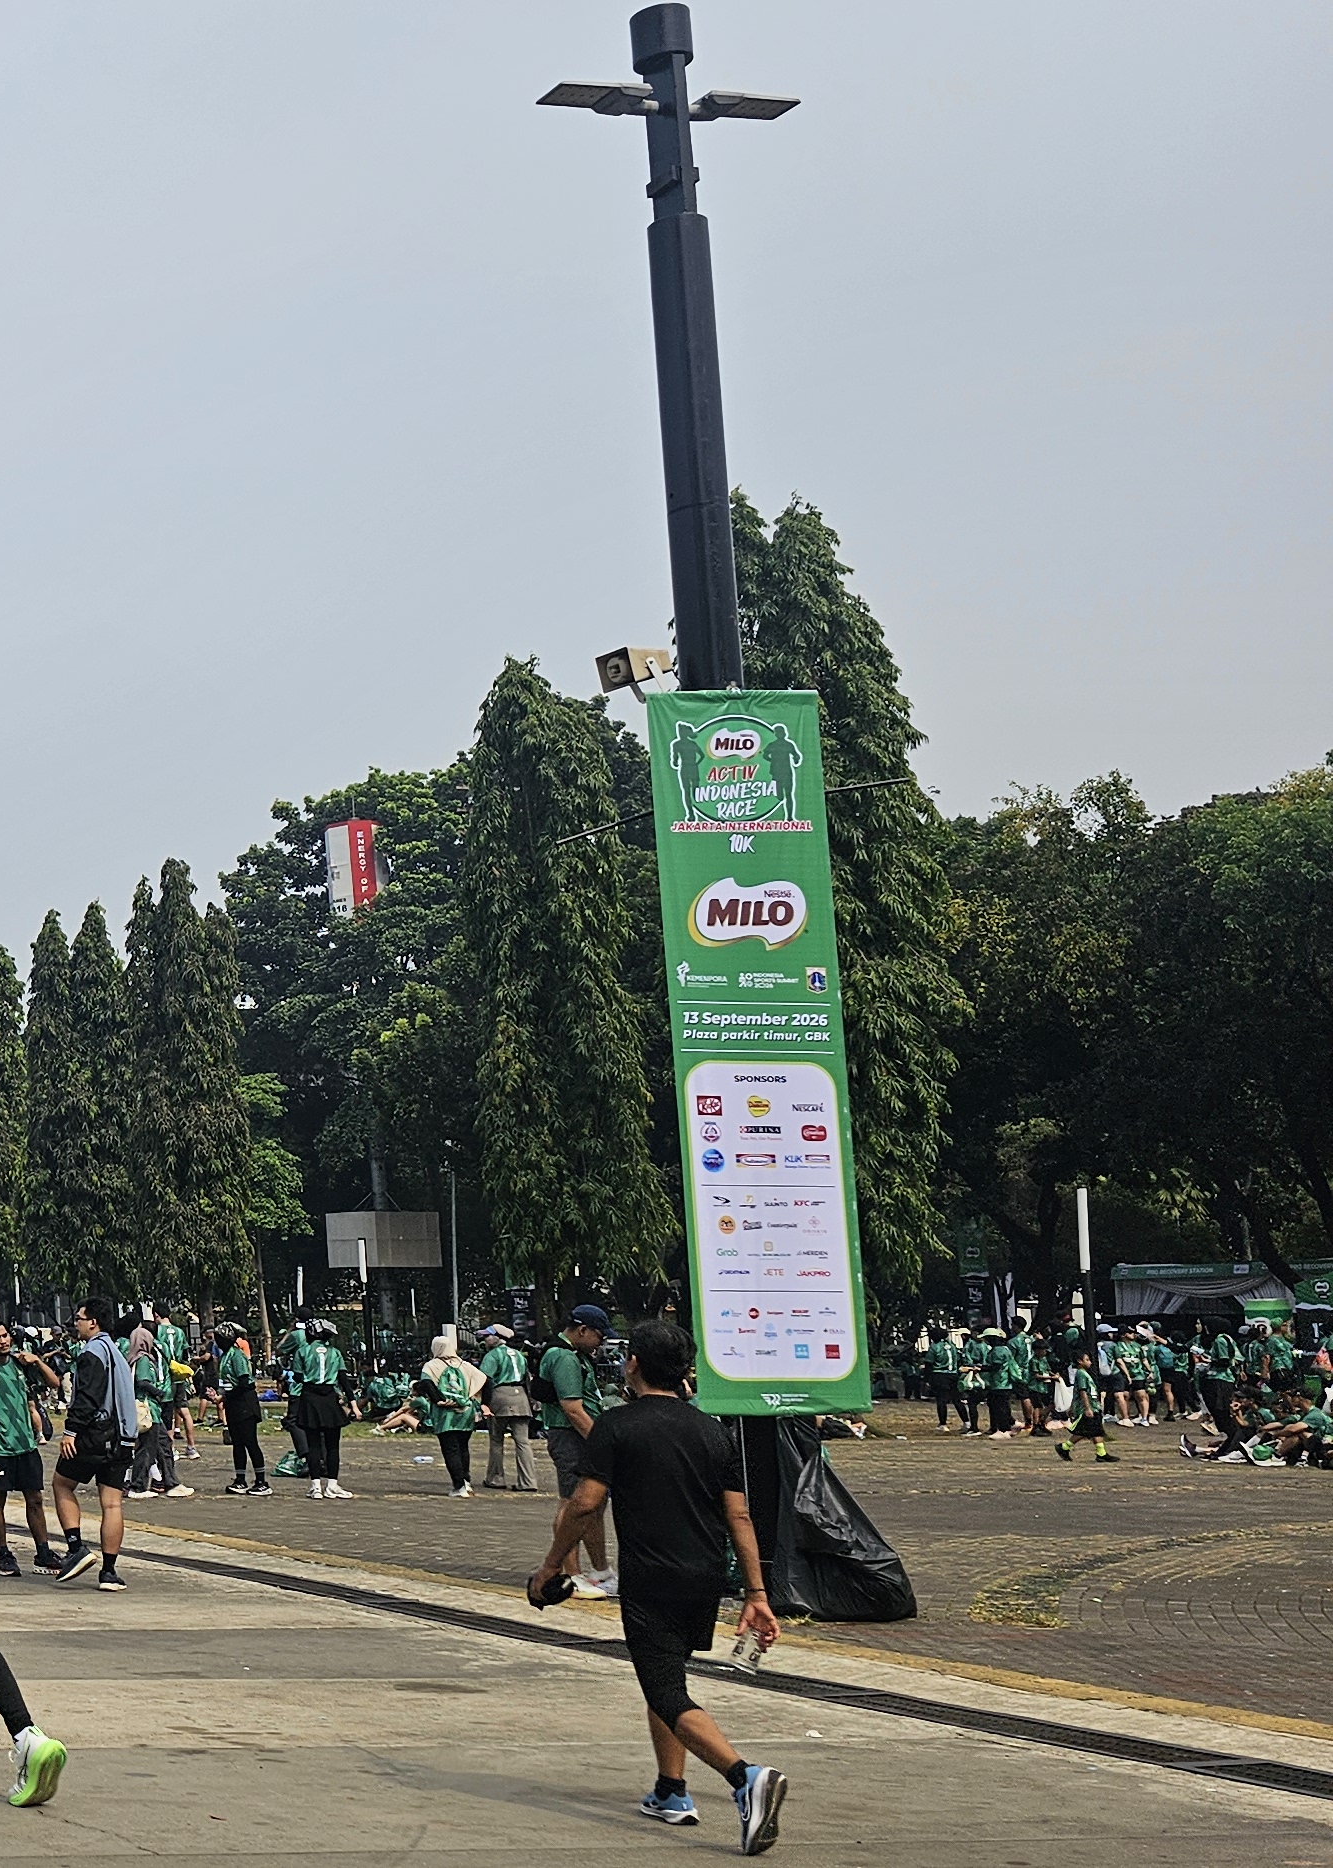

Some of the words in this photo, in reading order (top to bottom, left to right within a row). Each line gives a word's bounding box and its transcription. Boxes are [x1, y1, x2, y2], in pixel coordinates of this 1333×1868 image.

[715, 738, 754, 751] MILO
[707, 764, 759, 782] ACTIV
[695, 780, 777, 803] INDONESIA
[716, 799, 757, 819] RACE
[671, 822, 724, 832] JAKARTA
[725, 821, 813, 832] INTERNATIONAL
[729, 833, 756, 853] 10K
[357, 832, 367, 871] ENERGY
[707, 899, 794, 926] MILO
[683, 1012, 700, 1023] 13
[702, 1012, 788, 1027] September
[791, 1014, 828, 1026] 2026
[683, 1030, 718, 1039] Plaza
[721, 1030, 760, 1042] parkir
[763, 1030, 801, 1042] timur,
[805, 1032, 830, 1041] GBK
[734, 1075, 787, 1083] SPONSORS
[717, 1248, 738, 1256] Grab
